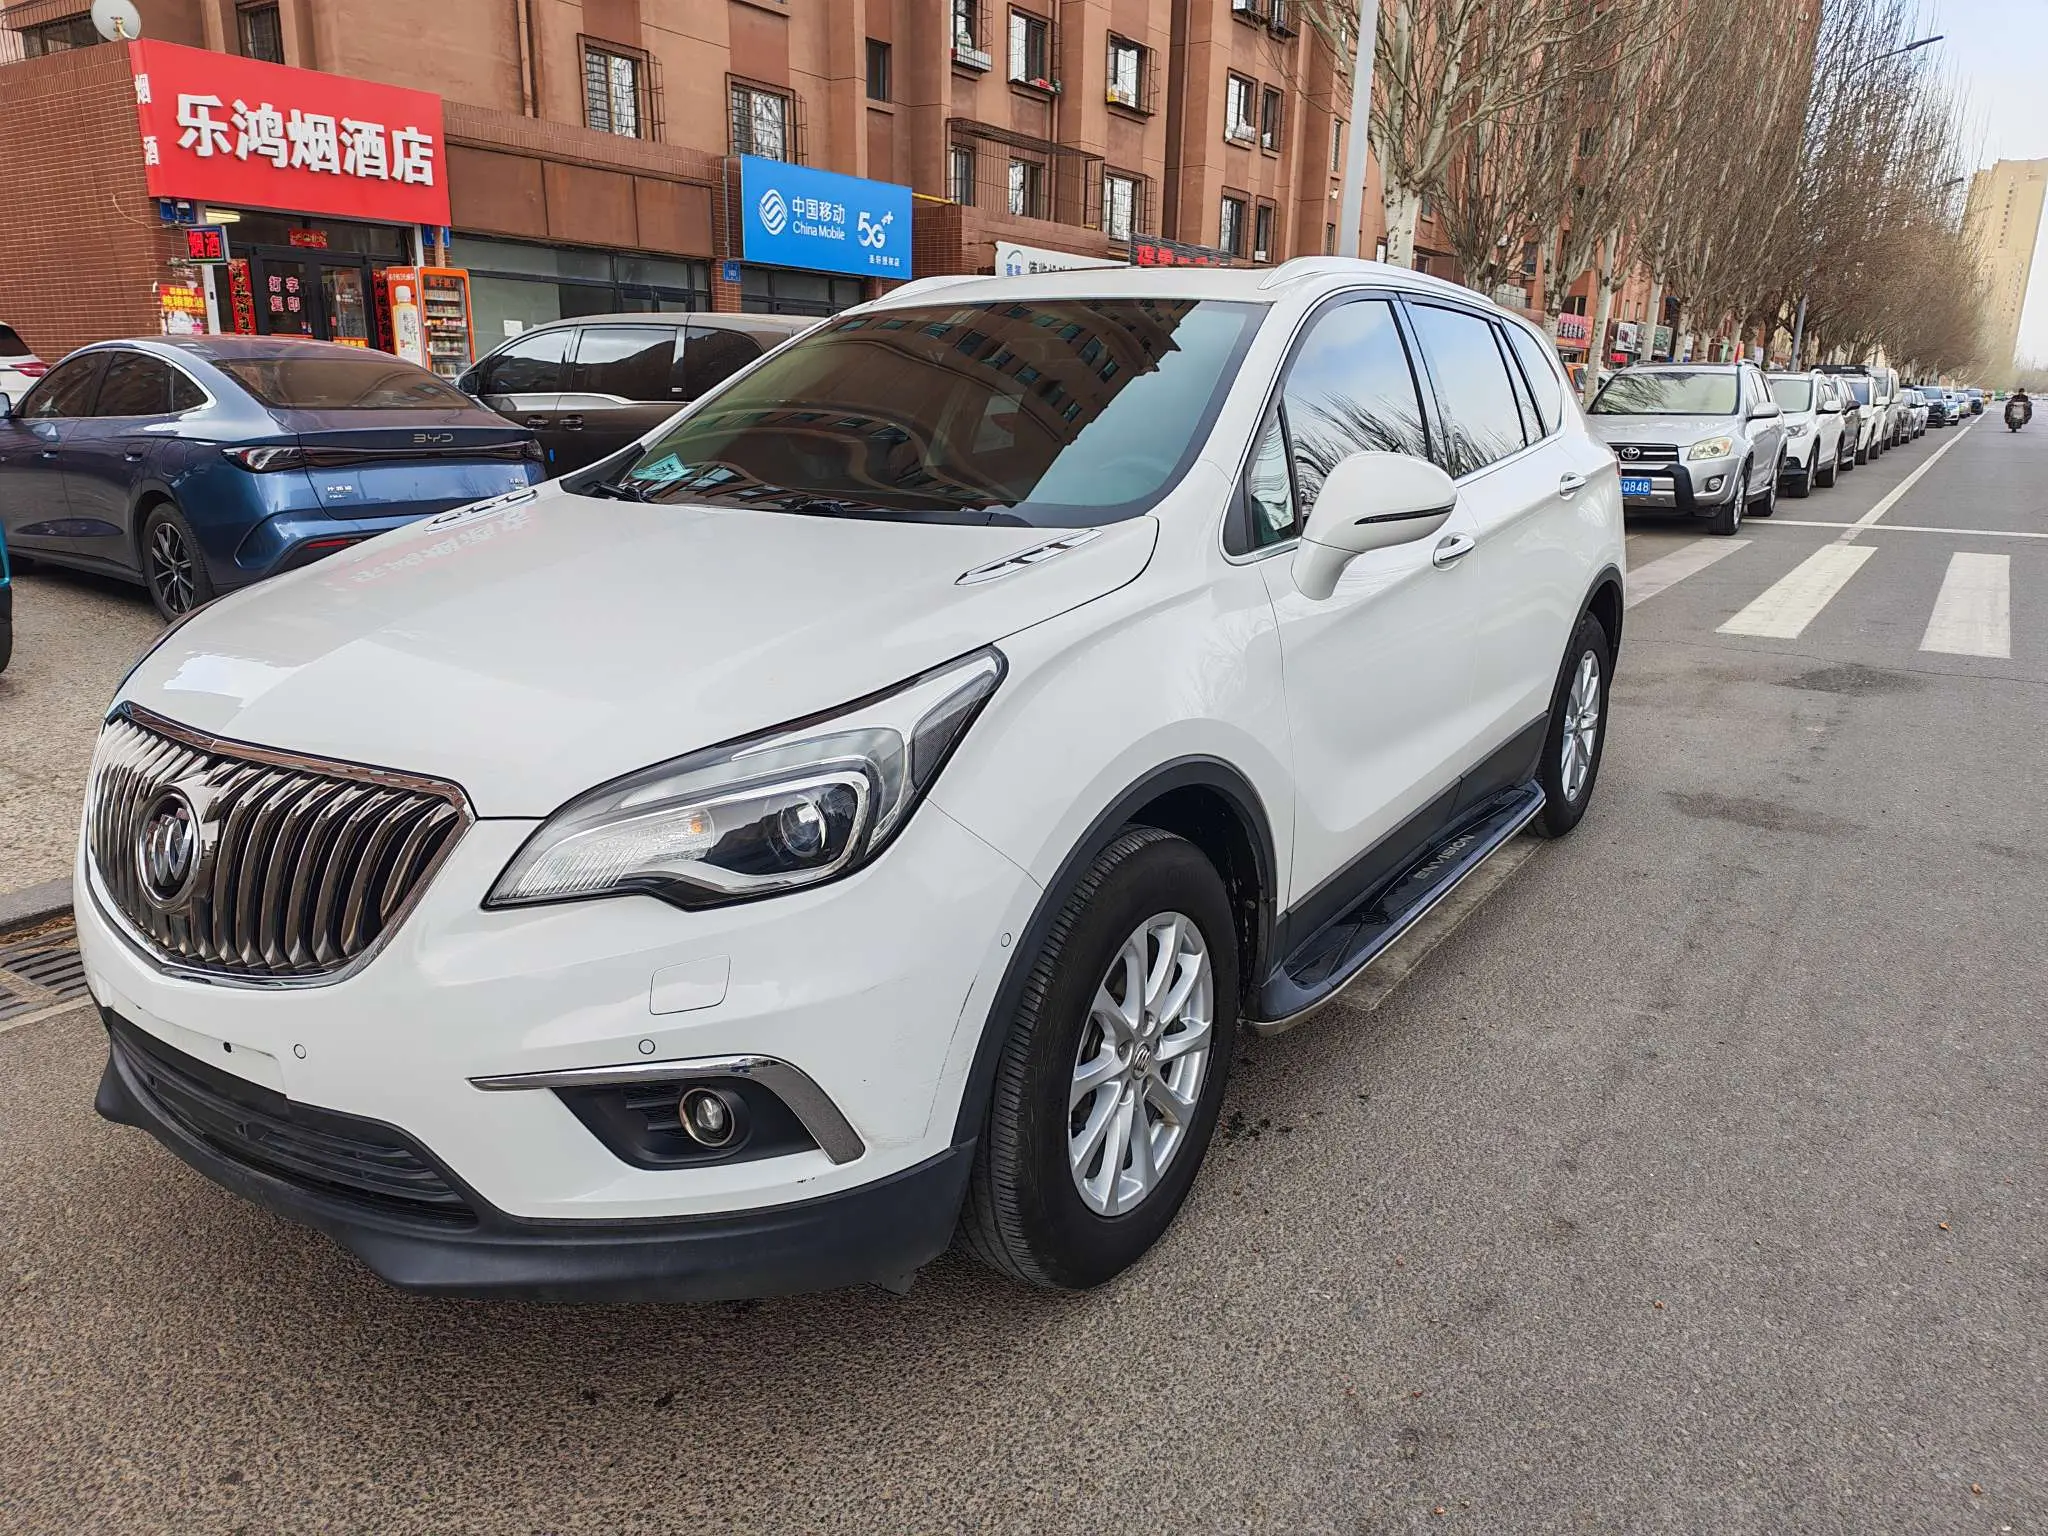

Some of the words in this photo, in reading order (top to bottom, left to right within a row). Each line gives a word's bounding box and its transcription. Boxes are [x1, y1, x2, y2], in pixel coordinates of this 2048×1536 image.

[176, 93, 434, 186] 乐鸿烟酒店
[792, 196, 845, 224] 中国移动
[792, 221, 817, 237] China
[818, 225, 845, 241] Mobile
[189, 231, 221, 257] 烟酒
[268, 275, 300, 293] 打字
[270, 295, 300, 312] 复印
[413, 433, 454, 443] BYD
[1413, 834, 1475, 879] ENVISION
